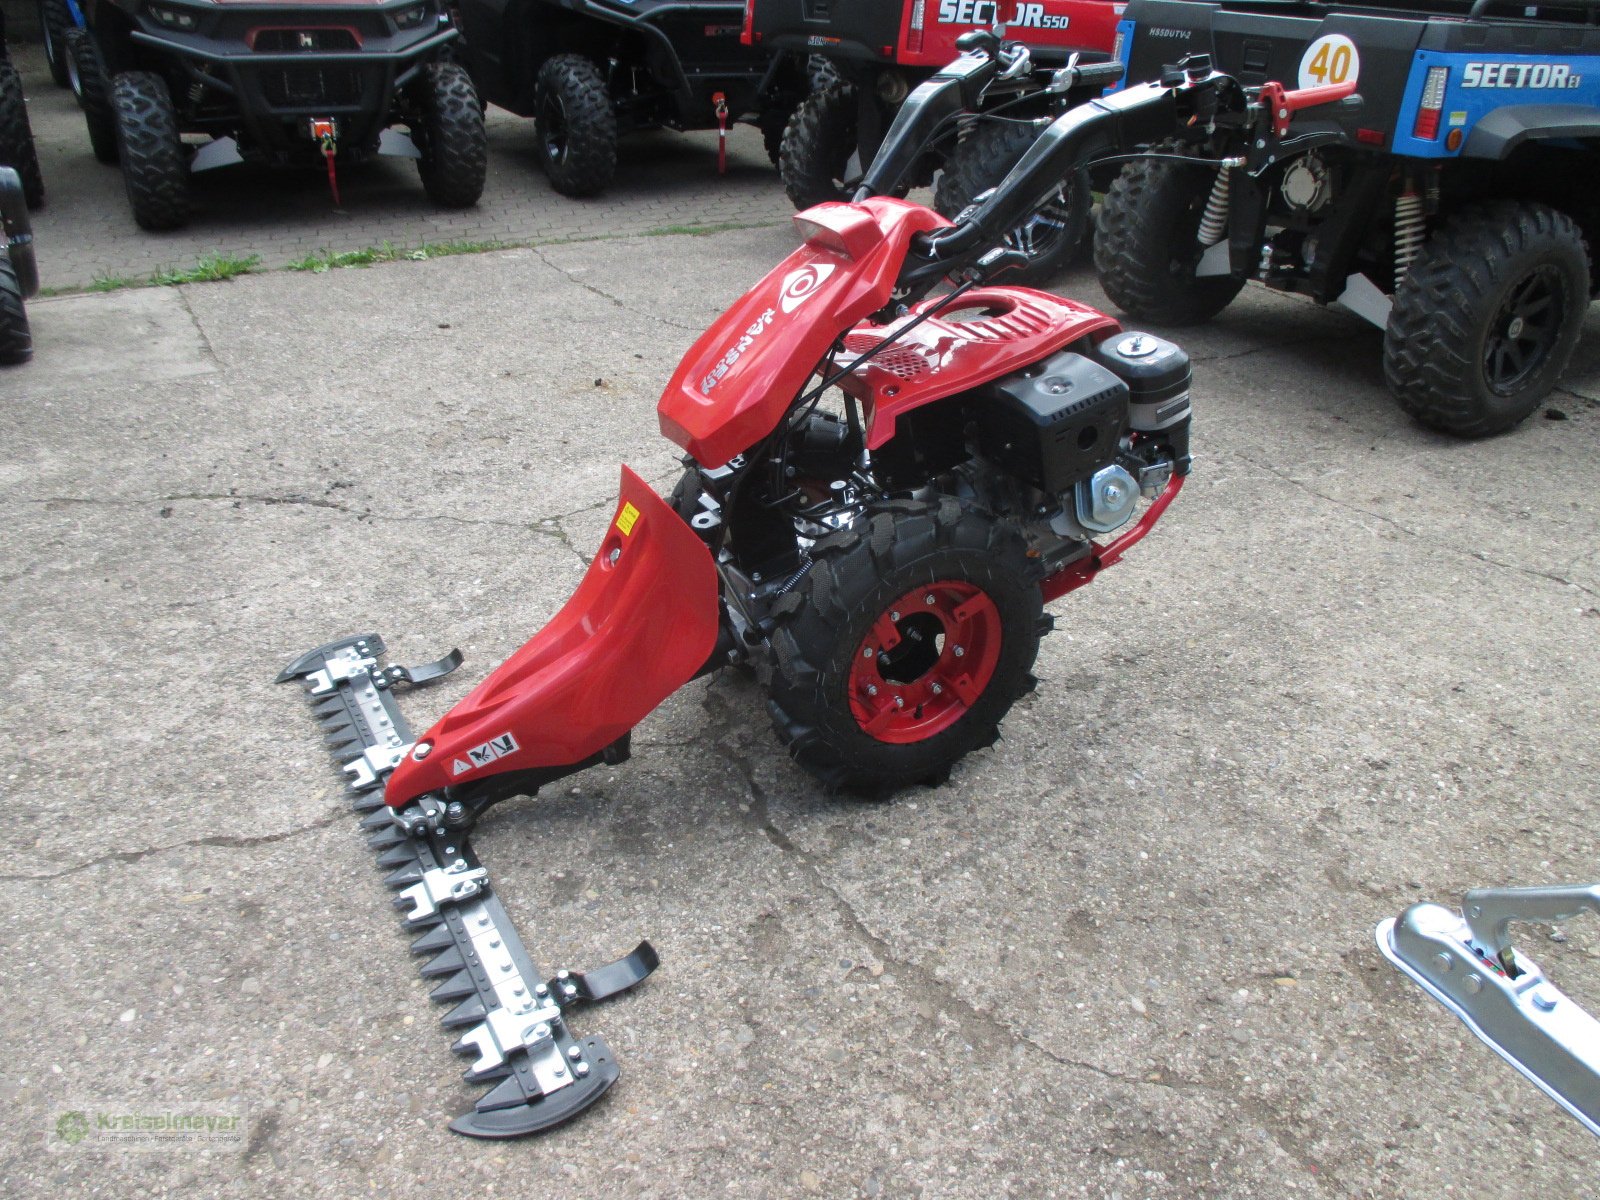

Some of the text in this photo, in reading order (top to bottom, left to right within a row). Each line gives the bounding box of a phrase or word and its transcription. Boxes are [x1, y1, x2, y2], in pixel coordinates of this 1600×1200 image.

[1042, 15, 1069, 29] 550
[1308, 43, 1351, 84] 40
[1461, 63, 1569, 88] SECTOR
[701, 309, 776, 395] JANSEN
